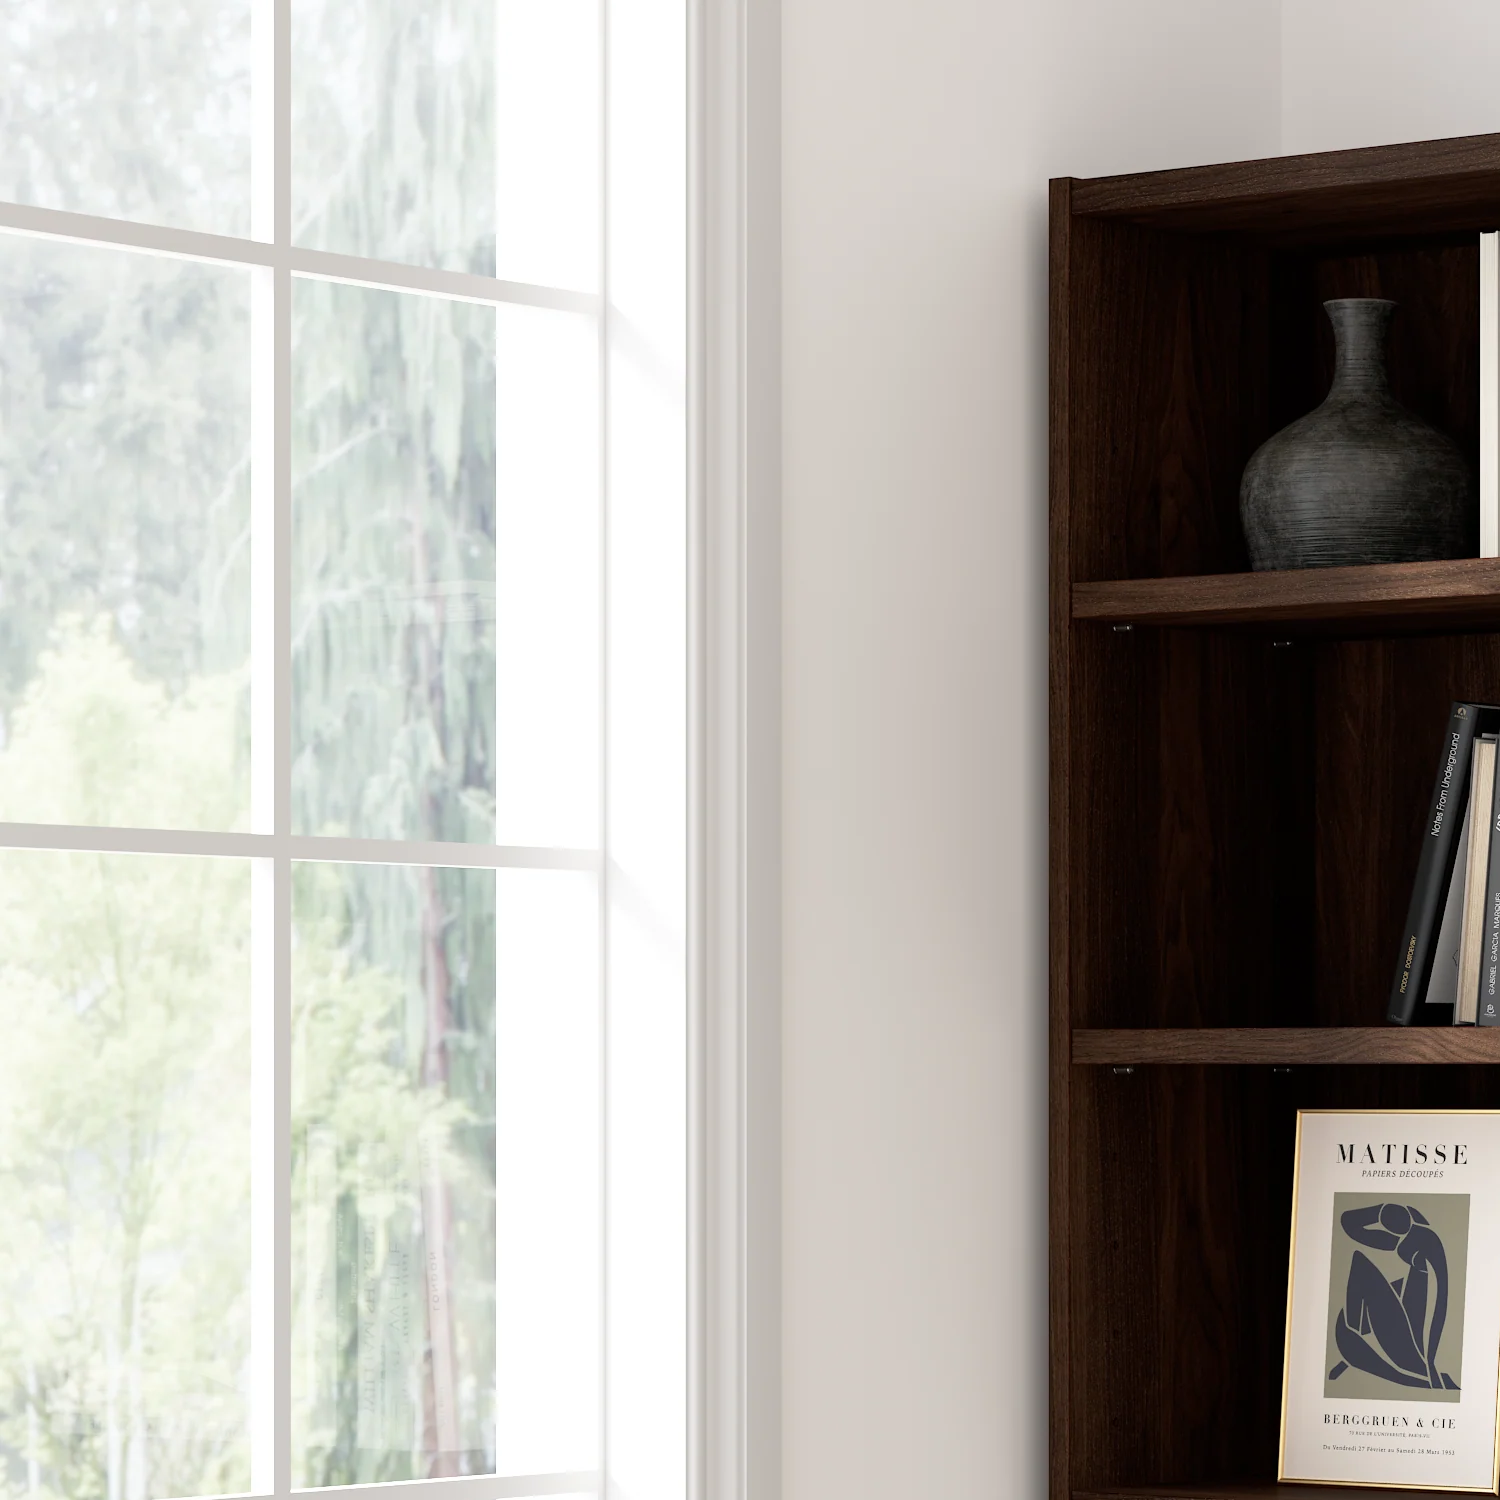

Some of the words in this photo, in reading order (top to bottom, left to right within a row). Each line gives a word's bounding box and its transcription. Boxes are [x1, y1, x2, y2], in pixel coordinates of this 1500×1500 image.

[1490, 932, 1500, 962] GARCIA
[1488, 965, 1497, 995] GABRIEL
[1336, 1143, 1469, 1166] MATISSE
[1361, 1169, 1397, 1179] PAPIERS
[1323, 1413, 1410, 1428] BERGGRUEN
[1416, 1417, 1424, 1428] &
[1431, 1418, 1456, 1430] CIE
